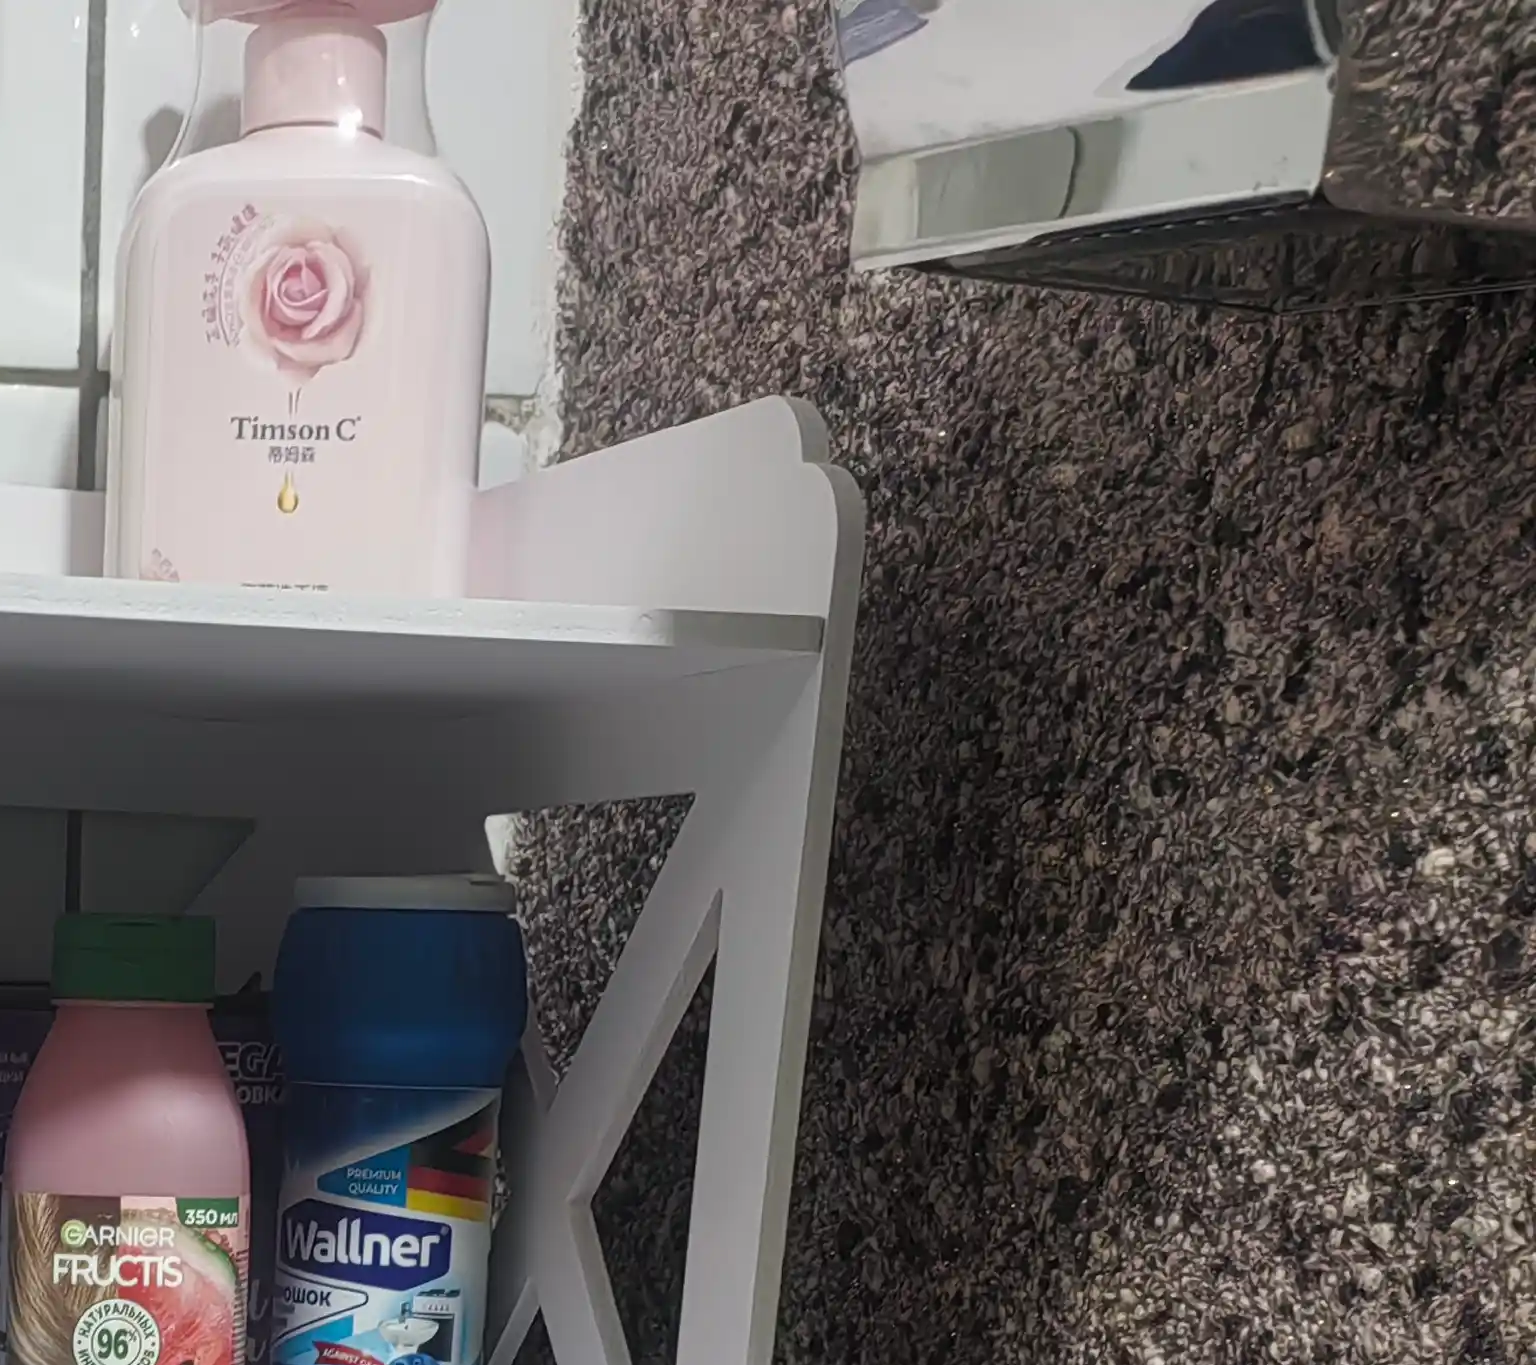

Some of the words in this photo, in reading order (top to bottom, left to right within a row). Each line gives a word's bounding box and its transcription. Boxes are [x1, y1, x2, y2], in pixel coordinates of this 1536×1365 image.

[230, 416, 331, 441] Timson
[346, 1166, 402, 1182] PREMIUM
[348, 1181, 398, 1196] QUALITY
[184, 1208, 218, 1226] 350
[220, 1211, 239, 1227] мл
[62, 1220, 175, 1248] GARNIER
[286, 1216, 441, 1268] Wallner
[52, 1252, 184, 1288] FRUCTIS
[283, 1285, 333, 1308] ОШОК
[78, 1303, 156, 1341] НАТУРАЛЬНЫХ
